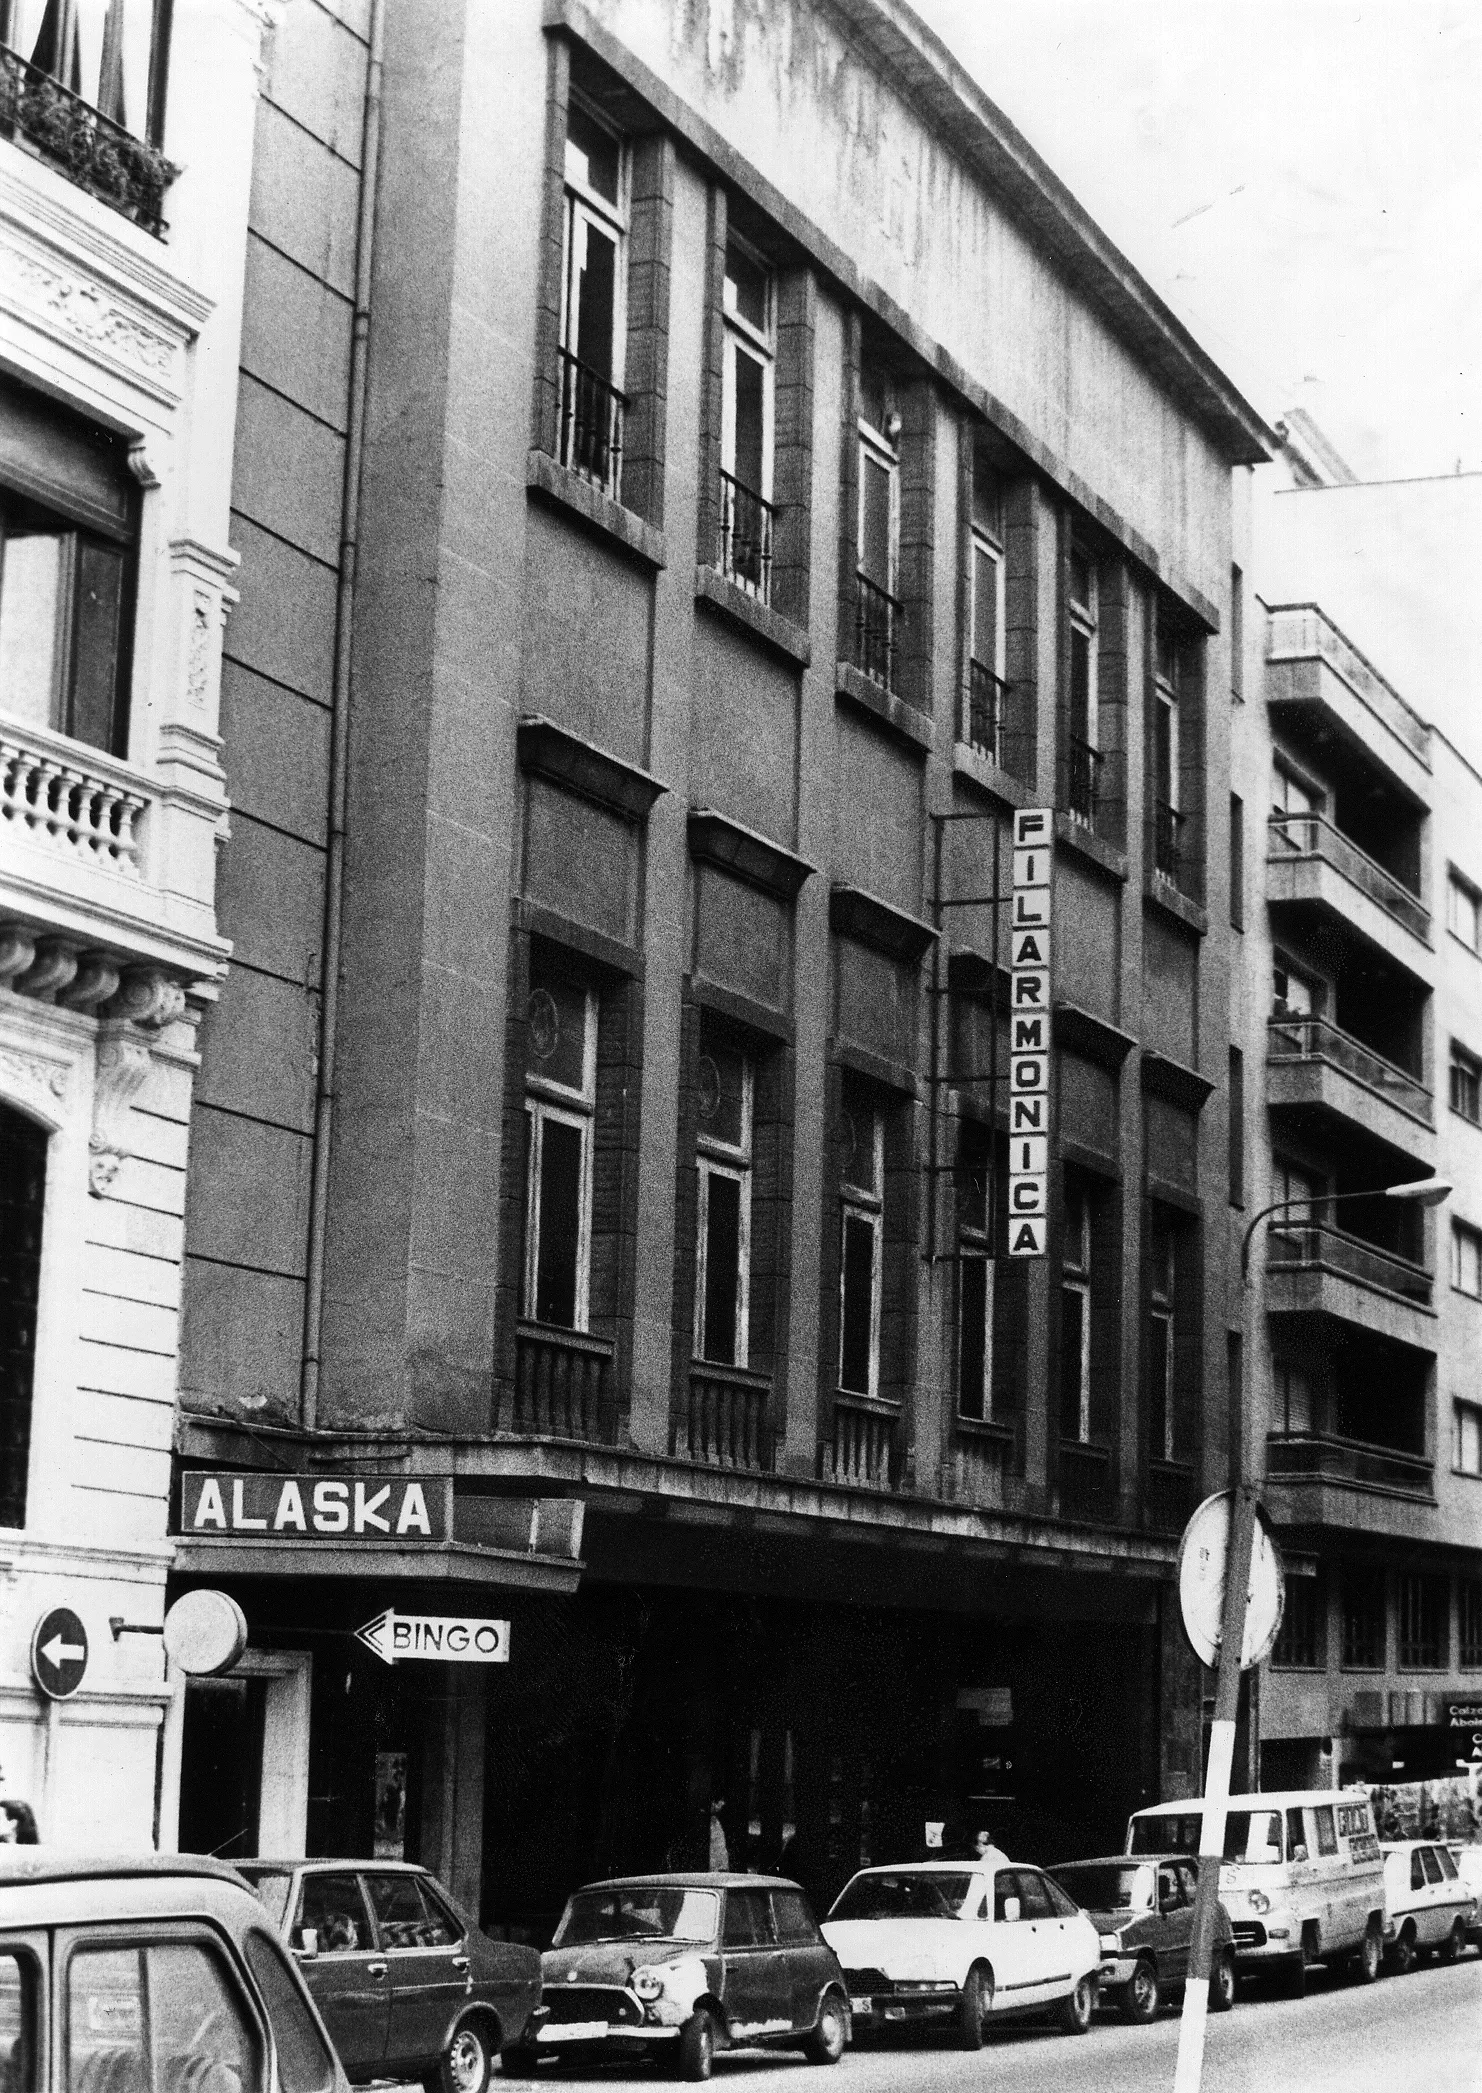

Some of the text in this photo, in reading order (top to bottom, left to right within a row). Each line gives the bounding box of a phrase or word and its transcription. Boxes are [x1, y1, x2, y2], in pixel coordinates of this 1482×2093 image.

[1012, 813, 1045, 1252] FILARMONICA
[194, 1478, 432, 1535] ALASKA
[392, 1621, 500, 1654] BINGO
